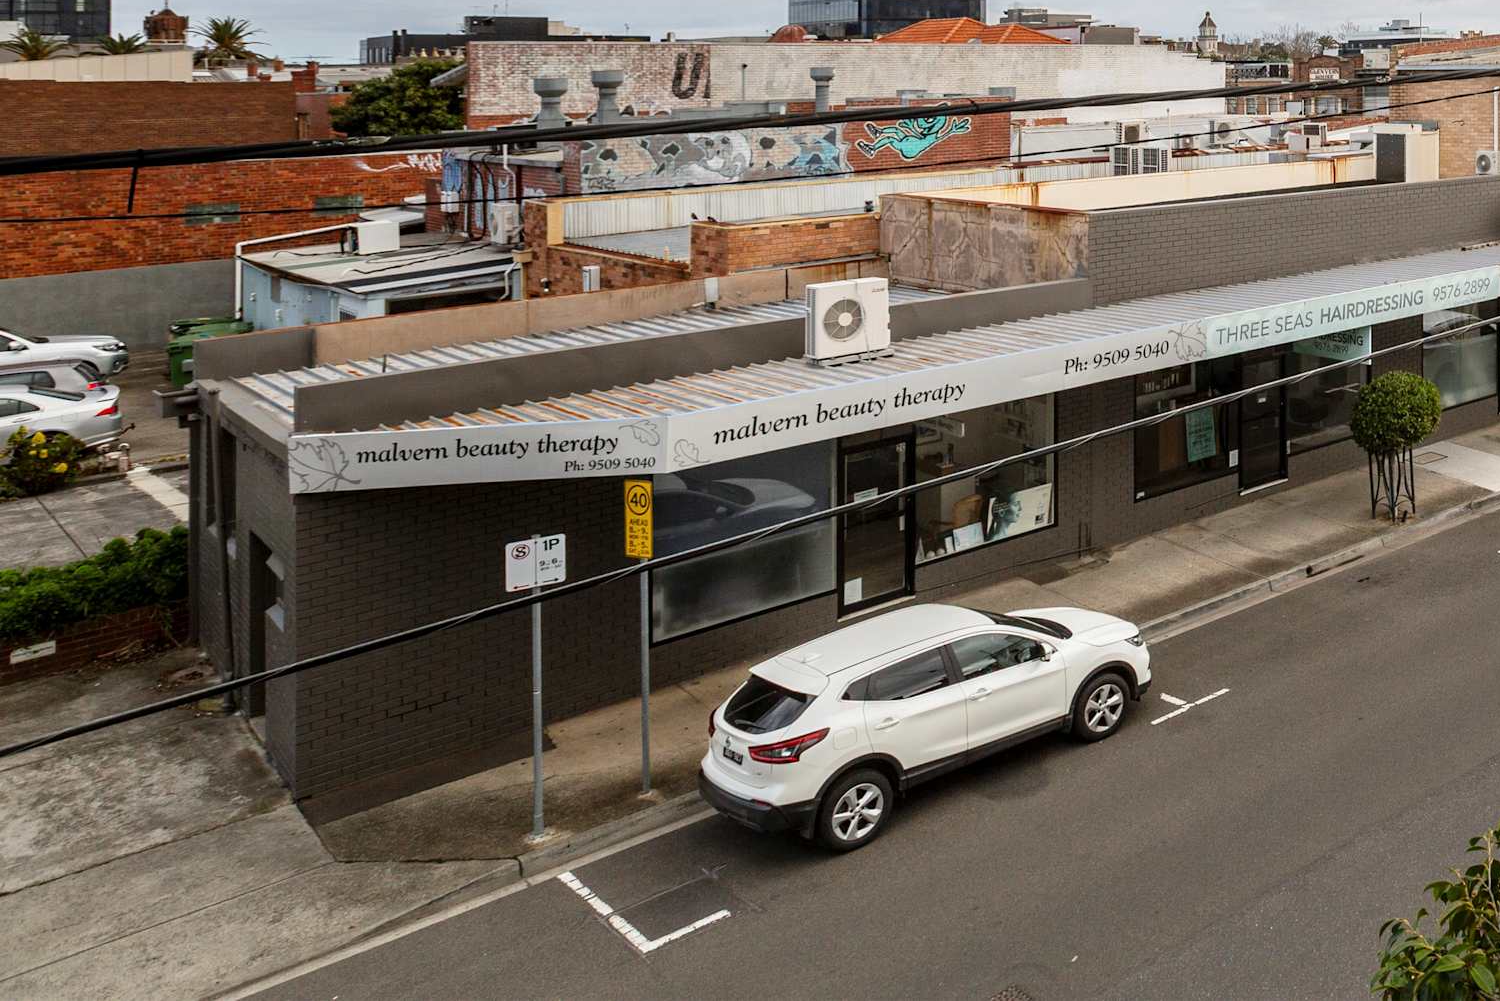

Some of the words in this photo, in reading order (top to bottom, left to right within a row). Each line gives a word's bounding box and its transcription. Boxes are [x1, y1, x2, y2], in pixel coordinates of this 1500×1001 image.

[1216, 319, 1270, 345] THREE
[1274, 311, 1313, 334] SEAS
[1320, 290, 1424, 325] HAIRDRESSING
[1432, 285, 1461, 303] 9576
[1464, 277, 1491, 296] 2899
[1063, 357, 1089, 375] Ph:
[1092, 347, 1131, 370] 9509
[1134, 340, 1170, 361] 5040
[713, 411, 809, 445] malvern
[816, 396, 887, 425] beauty
[894, 380, 967, 409] therapy
[356, 442, 450, 464] malvern
[456, 438, 529, 460] beauty
[537, 433, 620, 457] therapy
[564, 460, 585, 473] Ph:
[588, 458, 621, 471] 9509
[624, 456, 656, 470] 5040
[630, 493, 647, 508] 40
[543, 538, 560, 551] 1P
